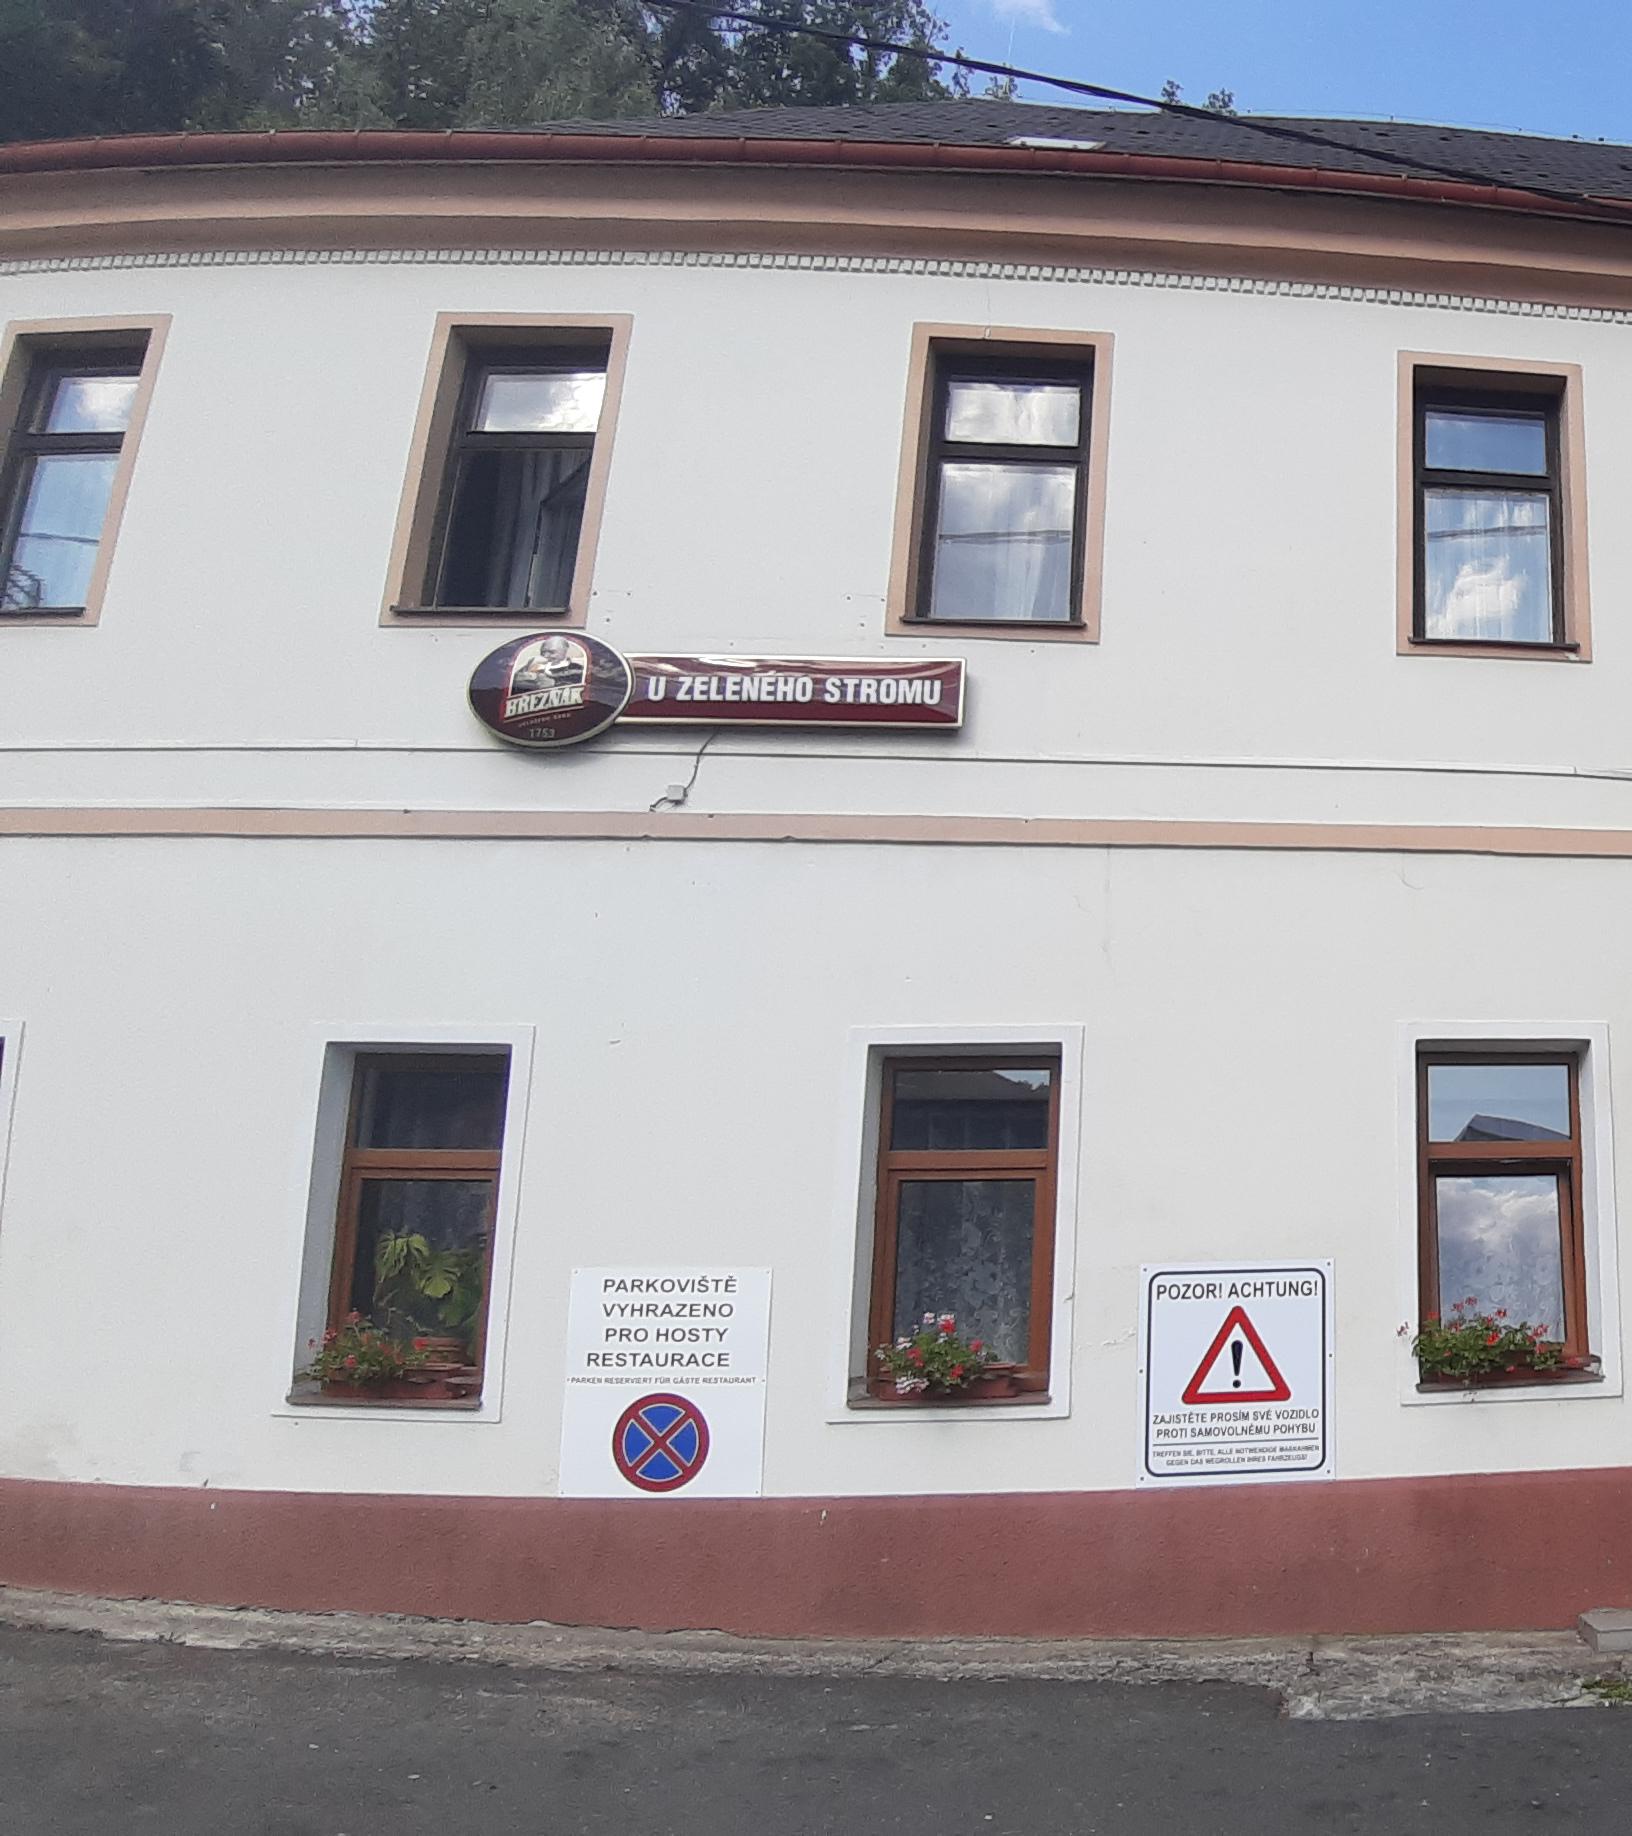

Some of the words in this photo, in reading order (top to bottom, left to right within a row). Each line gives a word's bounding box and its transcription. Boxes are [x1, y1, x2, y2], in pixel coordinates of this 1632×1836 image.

[648, 676, 665, 701] U
[676, 670, 813, 704] ZELENÉHO
[824, 676, 942, 705] STROMU
[529, 728, 556, 738] 1753
[603, 1275, 737, 1293] PARKOVIŠTĚ
[1156, 1283, 1223, 1300] POZOR!
[1228, 1280, 1318, 1298] ACHTUNG!
[602, 1303, 734, 1318] VYHRAZENO
[604, 1328, 649, 1342] PRO
[656, 1328, 729, 1342] HOSTY
[586, 1352, 730, 1367] RESTAURACE
[571, 1376, 602, 1384] PARKEN
[604, 1376, 652, 1384] RESERVIERT
[655, 1375, 671, 1384] FÜR
[702, 1376, 757, 1384] RESTAURANT
[1152, 1411, 1207, 1425] ZAJISTĚTE
[1210, 1410, 1250, 1422] PROSÍM
[1252, 1409, 1273, 1421] SVÉ
[1275, 1408, 1320, 1420] VOZIDLO
[1156, 1427, 1188, 1438] PROTI
[1190, 1424, 1270, 1437] SAMOVOLNÉMU
[1273, 1423, 1316, 1435] POHYBU
